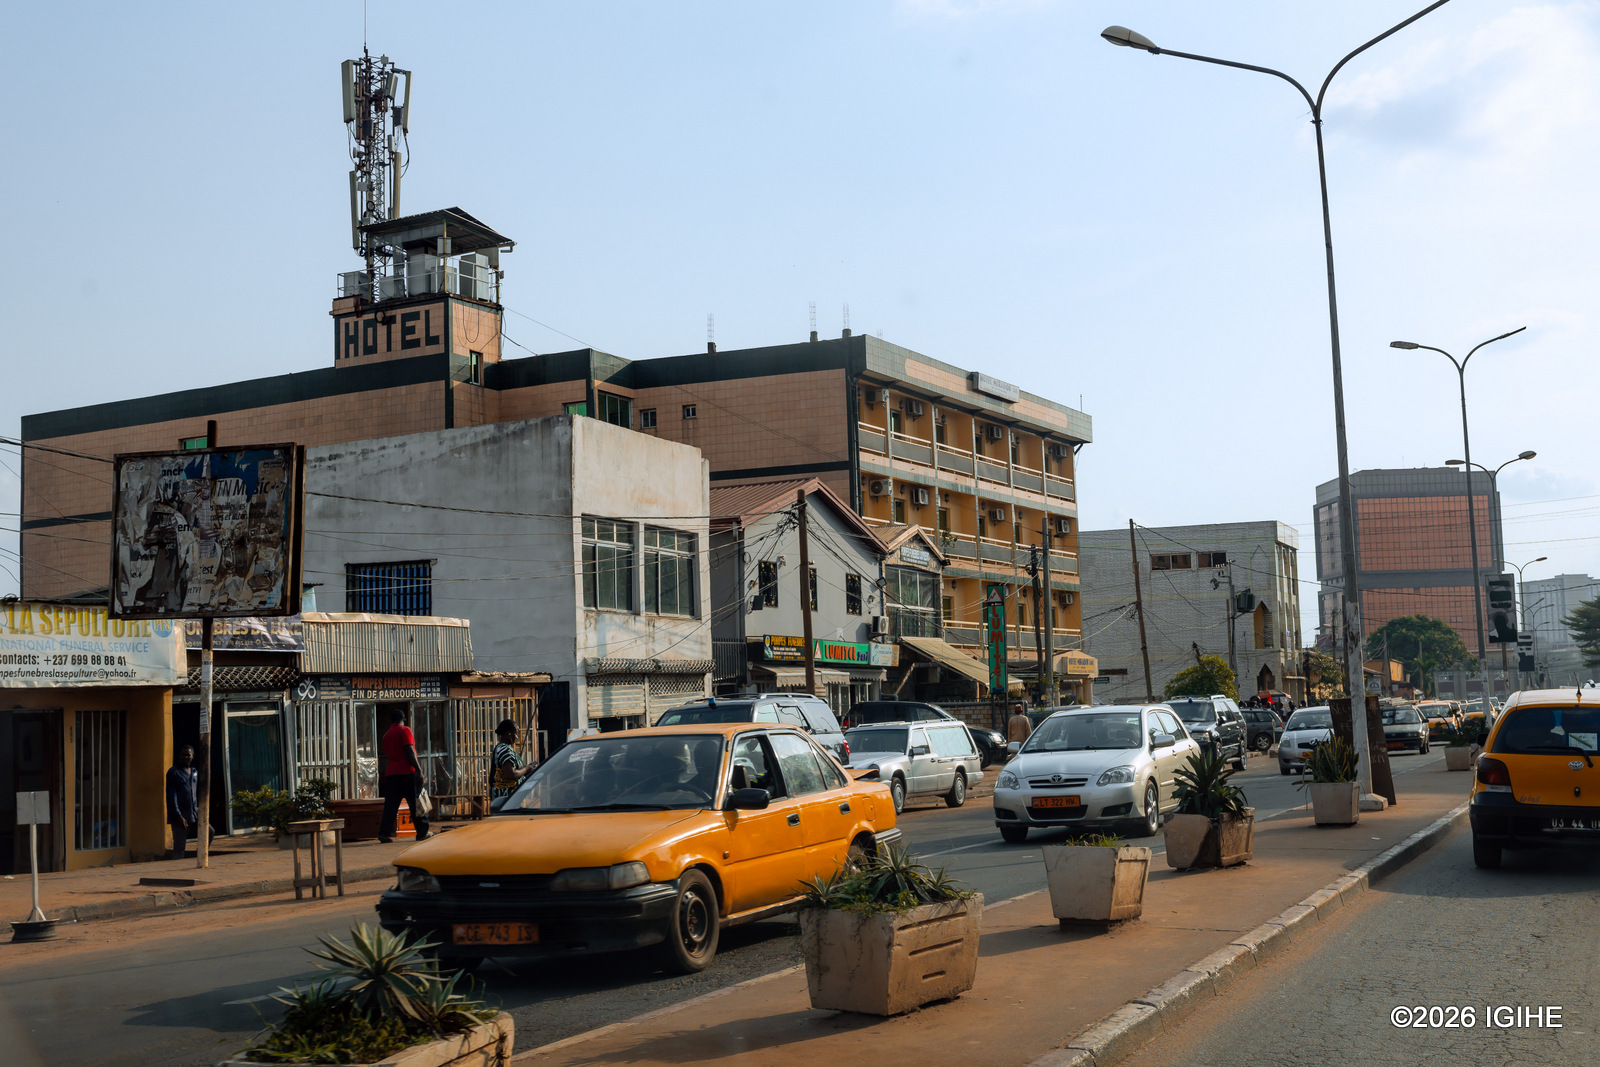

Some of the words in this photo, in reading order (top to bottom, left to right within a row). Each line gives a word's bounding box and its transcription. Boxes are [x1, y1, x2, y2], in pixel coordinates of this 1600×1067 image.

[344, 309, 439, 359] HOTEL
[233, 478, 270, 495] Msic
[8, 604, 34, 634] LA
[38, 604, 152, 638] SEPULTURE
[184, 620, 249, 637] UNBRES
[60, 641, 106, 652] FUNERAL
[108, 642, 149, 653] SERVICE
[43, 654, 69, 666] +237
[71, 654, 88, 666] 699
[352, 677, 384, 690] POMPES
[352, 689, 365, 699] FIN
[367, 689, 378, 699] DE
[379, 689, 421, 699] PARCOURS
